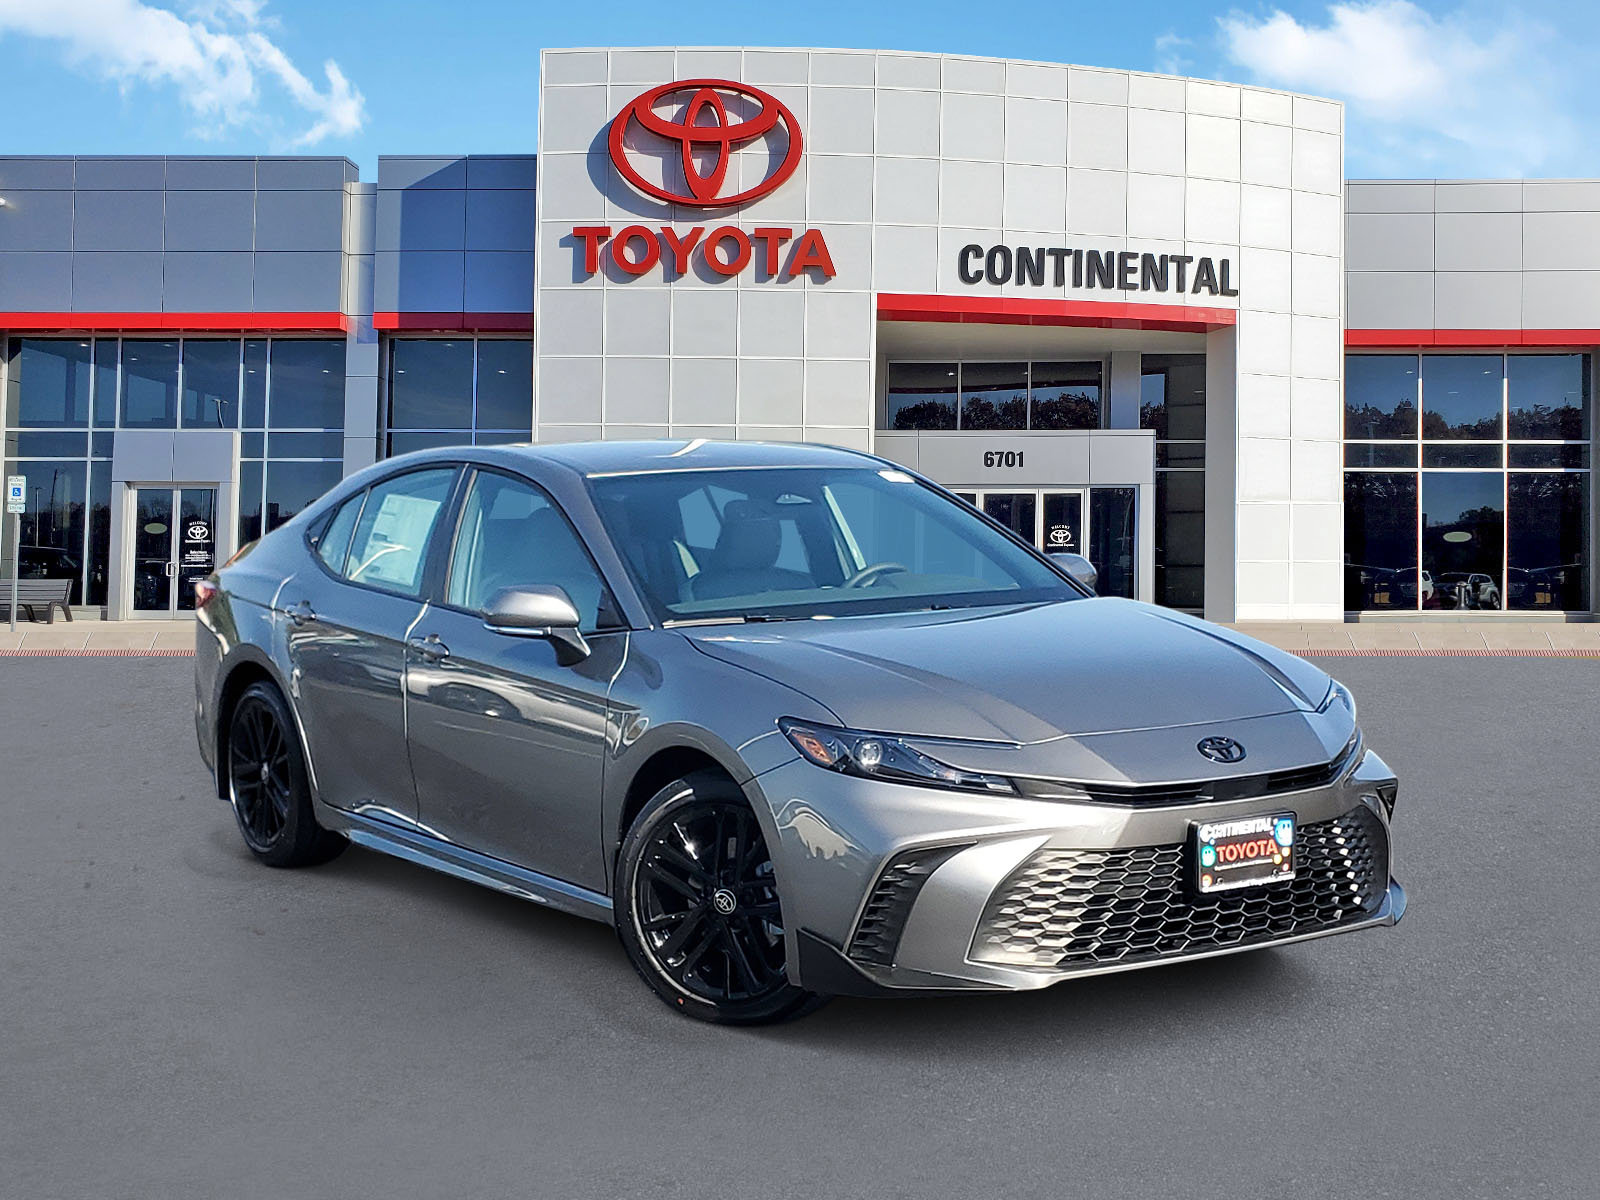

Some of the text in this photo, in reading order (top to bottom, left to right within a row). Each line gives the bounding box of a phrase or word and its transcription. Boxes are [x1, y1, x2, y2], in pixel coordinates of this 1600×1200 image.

[573, 225, 837, 277] TOYOTA
[958, 244, 1239, 297] CONTINENTAL
[983, 450, 1024, 468] 6701
[1216, 839, 1279, 862] TOYOTA
